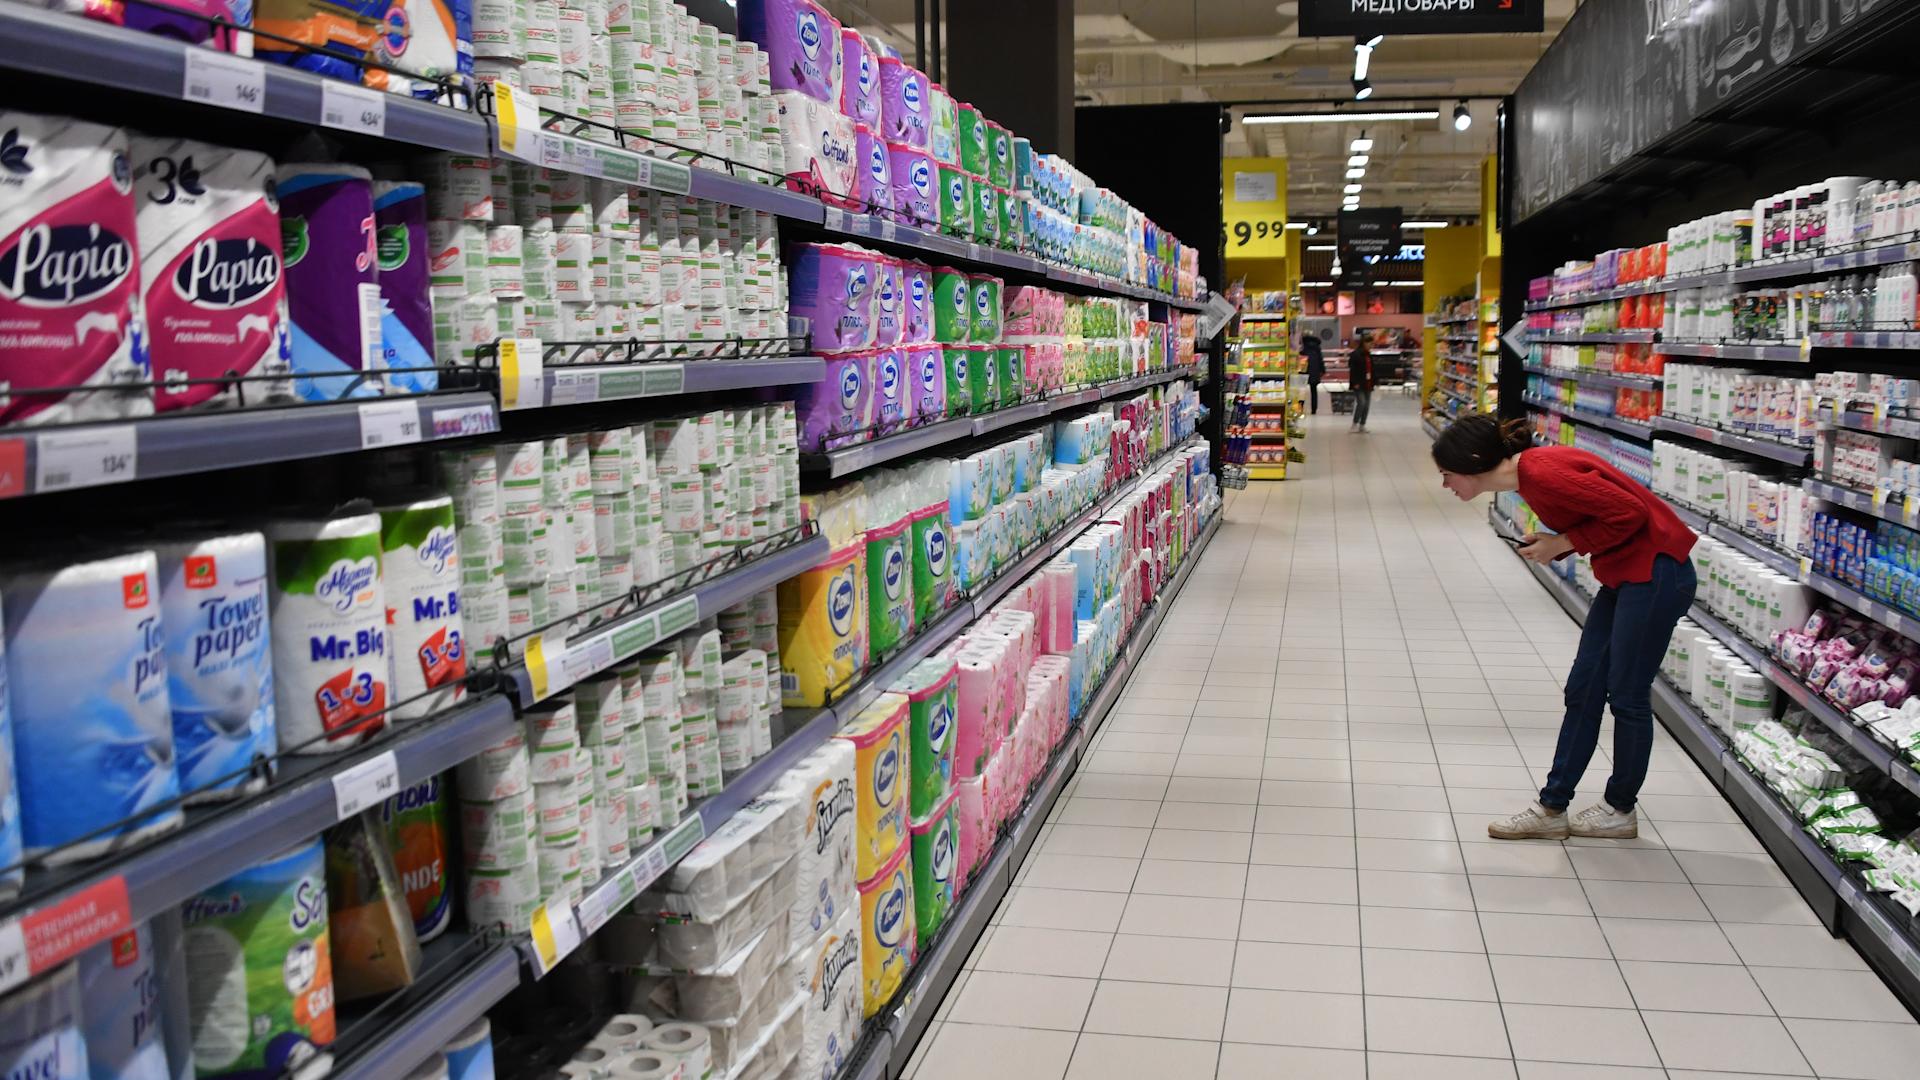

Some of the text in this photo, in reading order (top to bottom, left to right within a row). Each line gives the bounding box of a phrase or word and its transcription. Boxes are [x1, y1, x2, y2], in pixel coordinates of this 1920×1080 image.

[147, 156, 177, 206] 3
[1256, 221, 1284, 239] 99
[12, 223, 127, 302] Papia
[188, 237, 277, 306] Papia
[193, 615, 264, 669] paper
